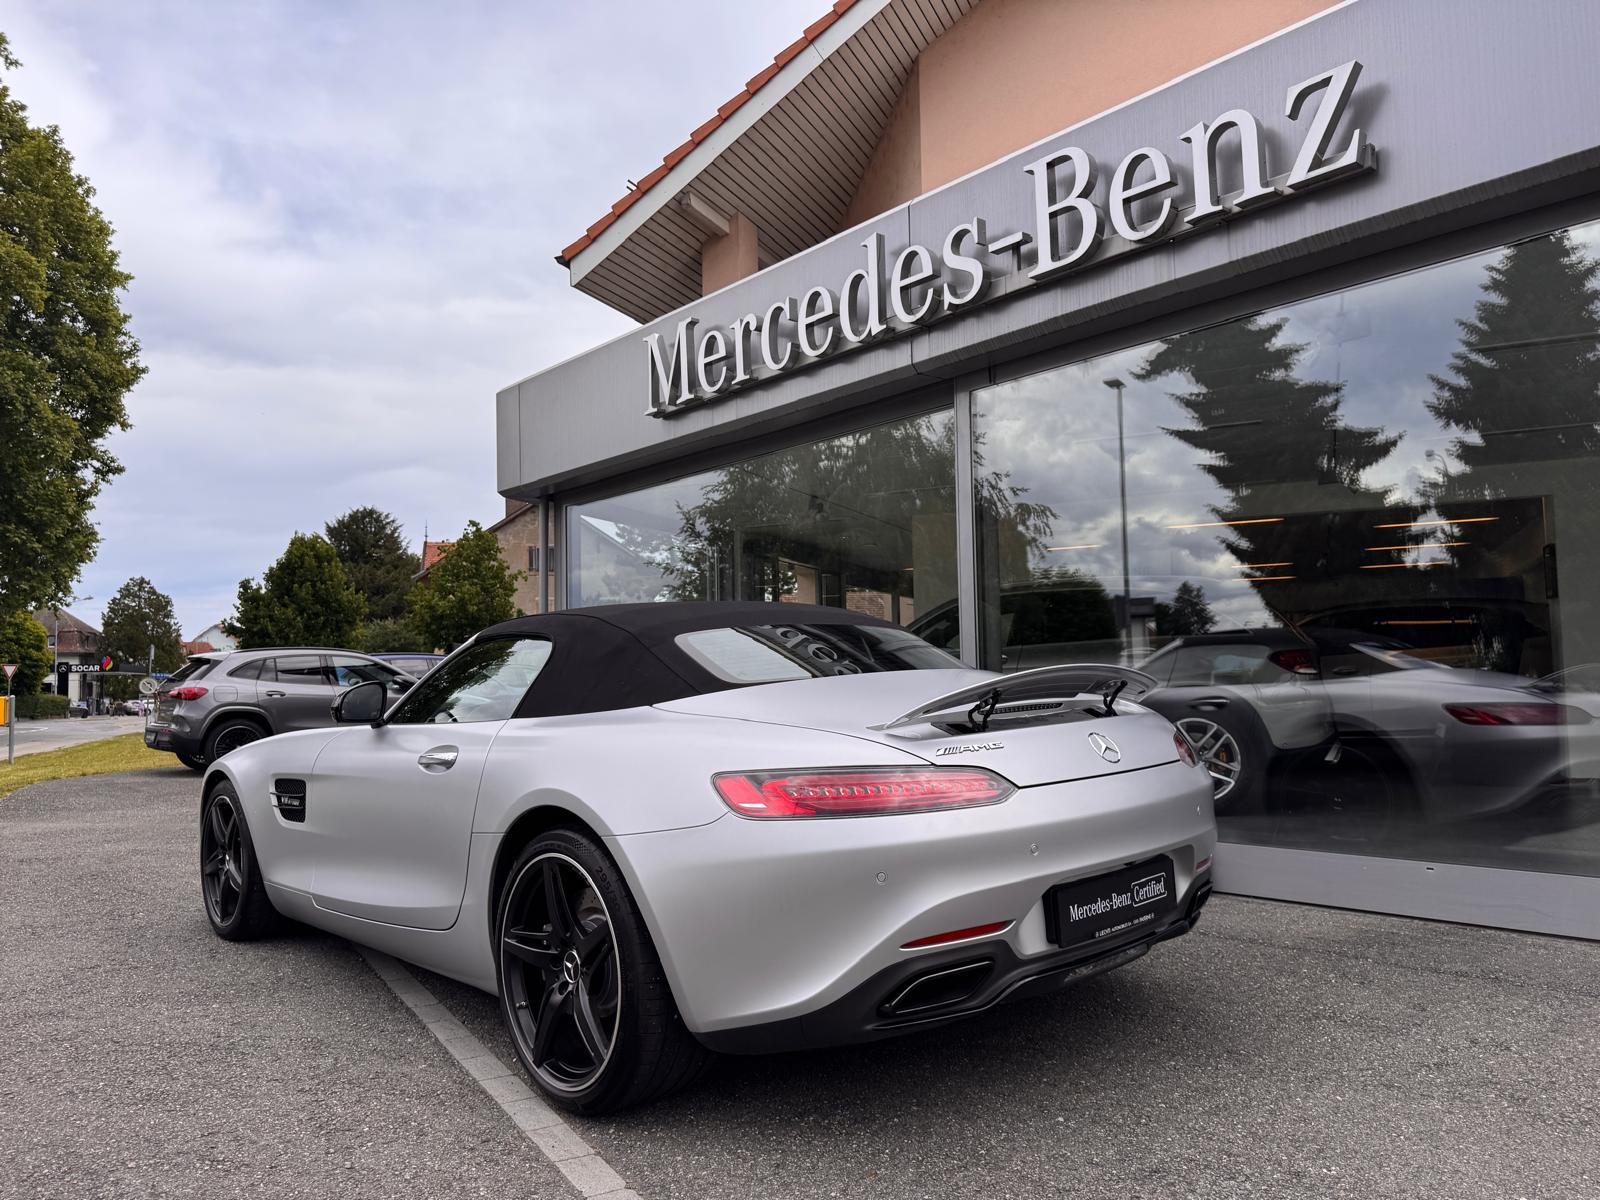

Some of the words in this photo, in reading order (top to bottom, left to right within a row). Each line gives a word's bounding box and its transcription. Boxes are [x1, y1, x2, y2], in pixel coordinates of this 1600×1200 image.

[643, 60, 1372, 416] Mercedes-Benz
[70, 664, 100, 673] SOCAR
[1069, 892, 1132, 923] Mercedes-Benz
[1133, 877, 1165, 902] Certified
